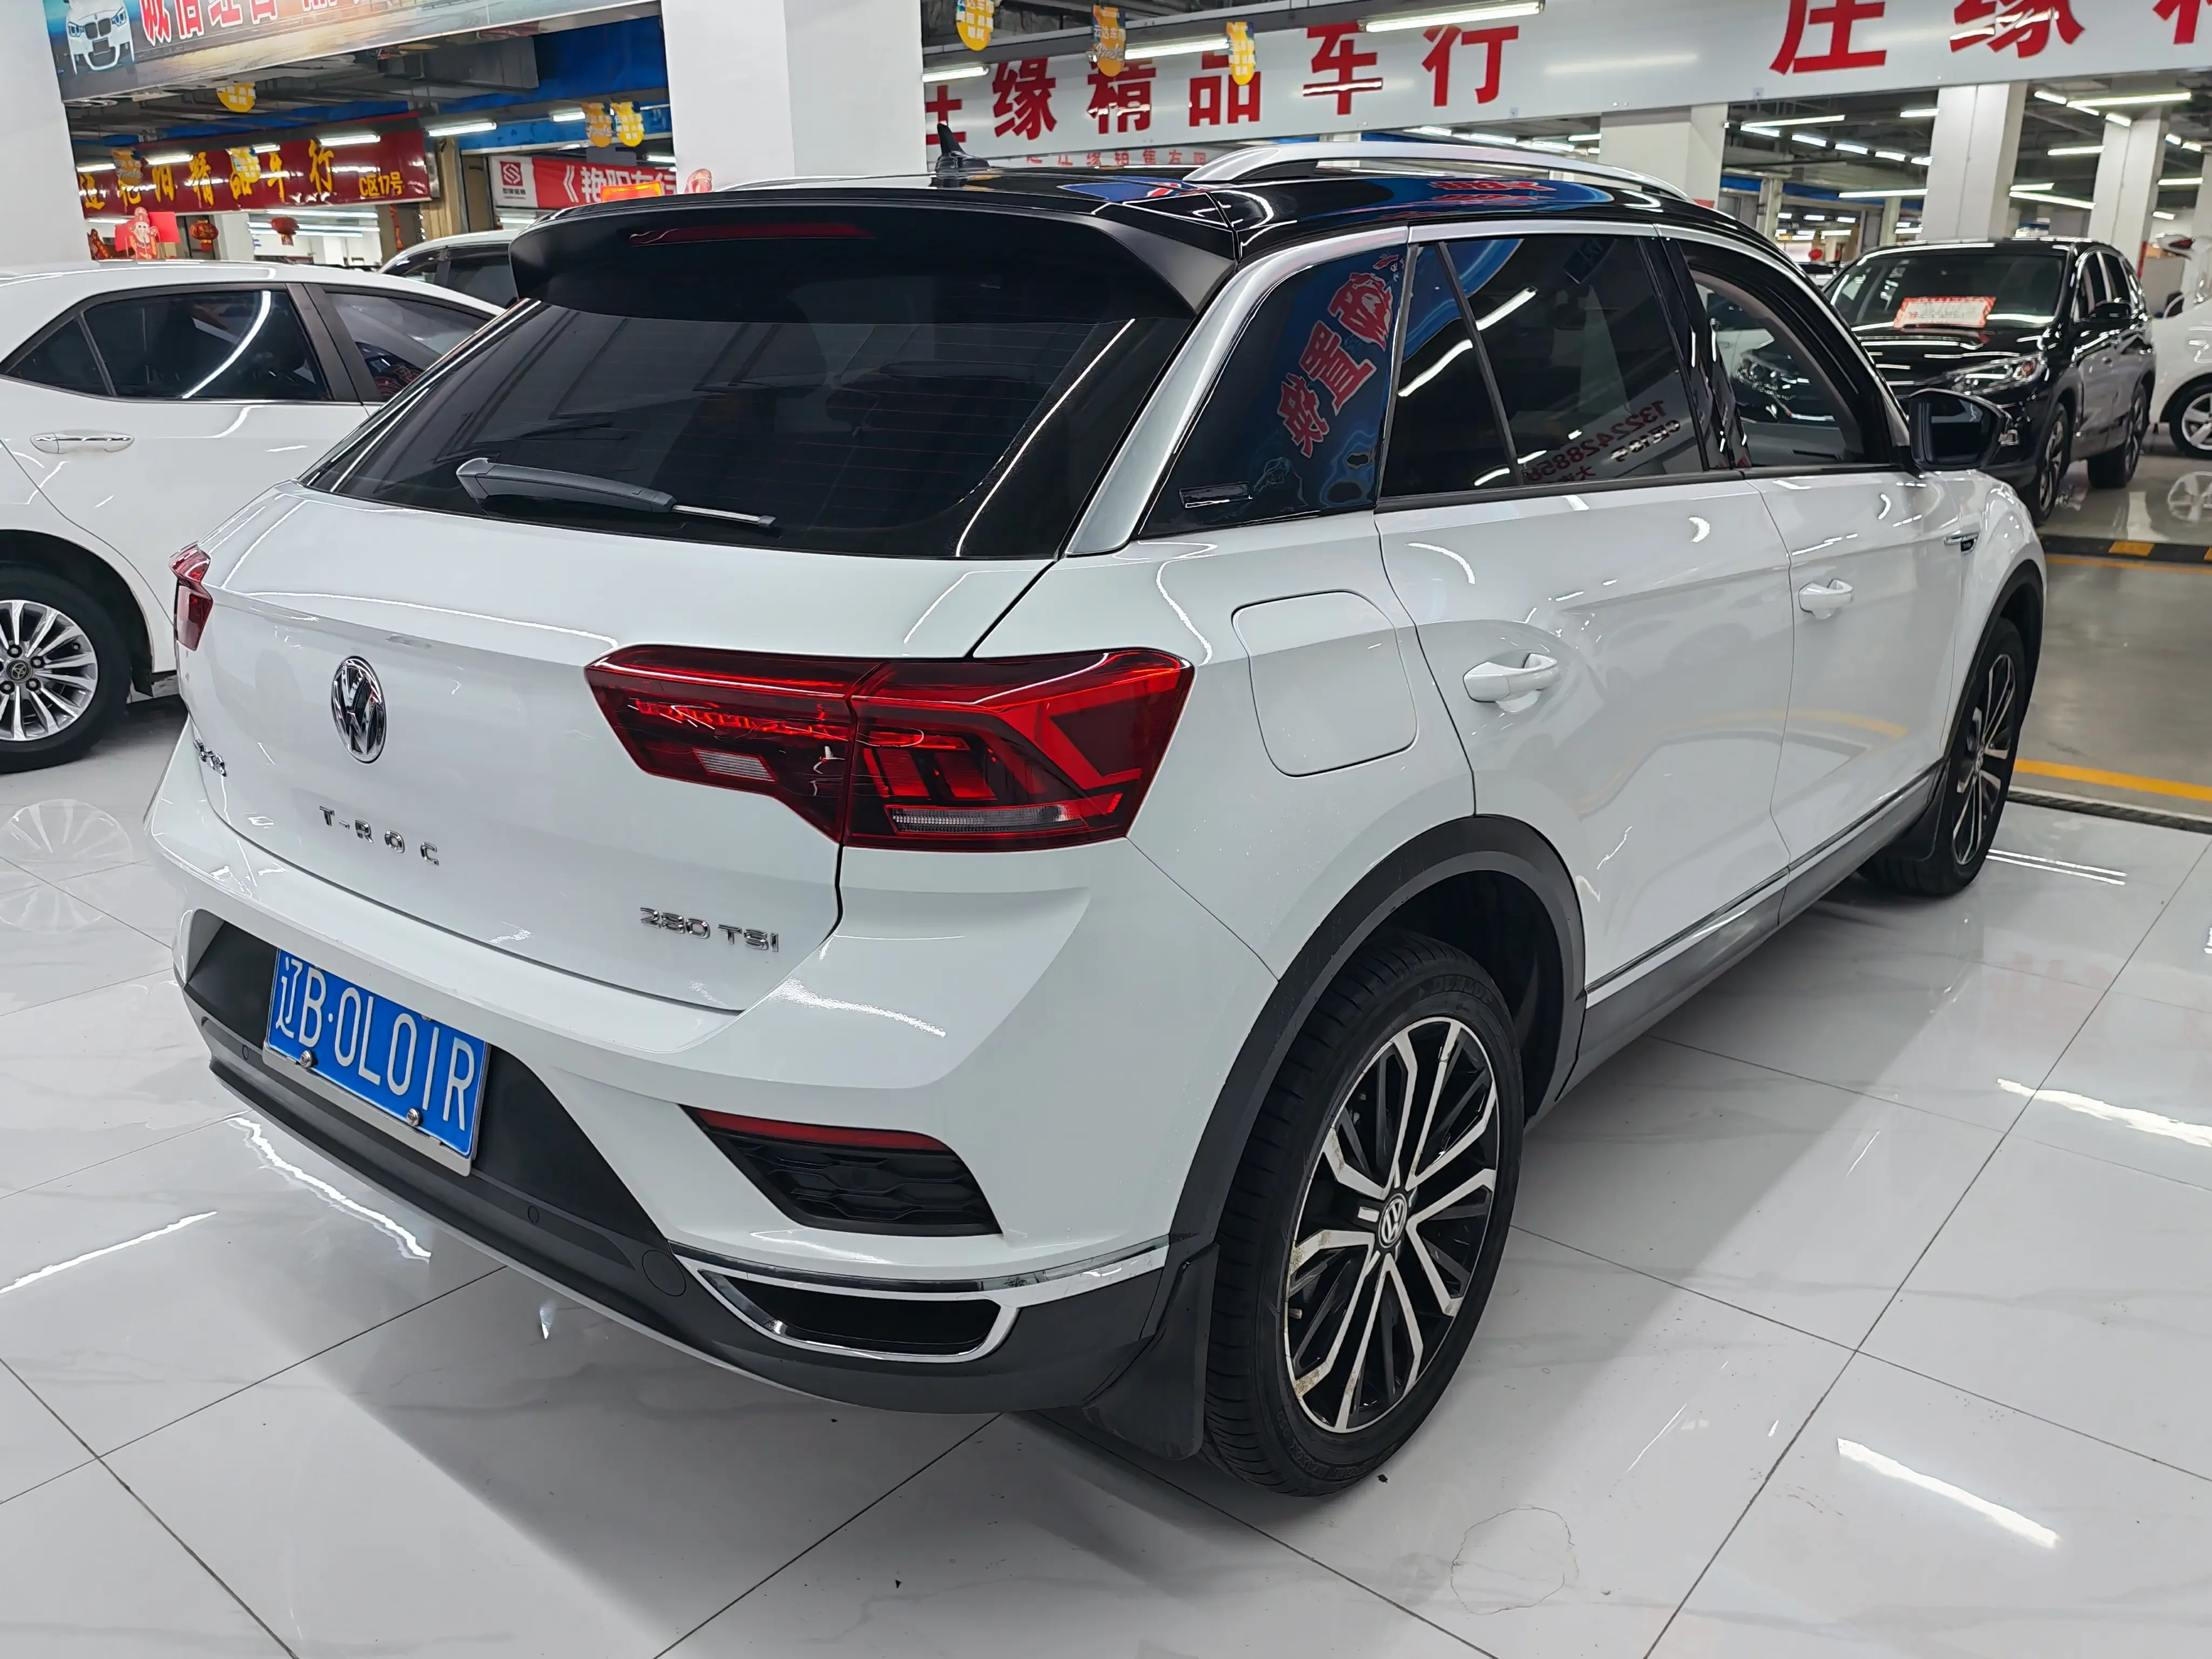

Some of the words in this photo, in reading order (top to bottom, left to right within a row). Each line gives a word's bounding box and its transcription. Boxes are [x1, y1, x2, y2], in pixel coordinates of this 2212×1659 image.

[359, 171, 403, 198] C区17号
[319, 805, 440, 866] T-ROC
[640, 907, 711, 940] 280
[718, 923, 779, 953] TSI
